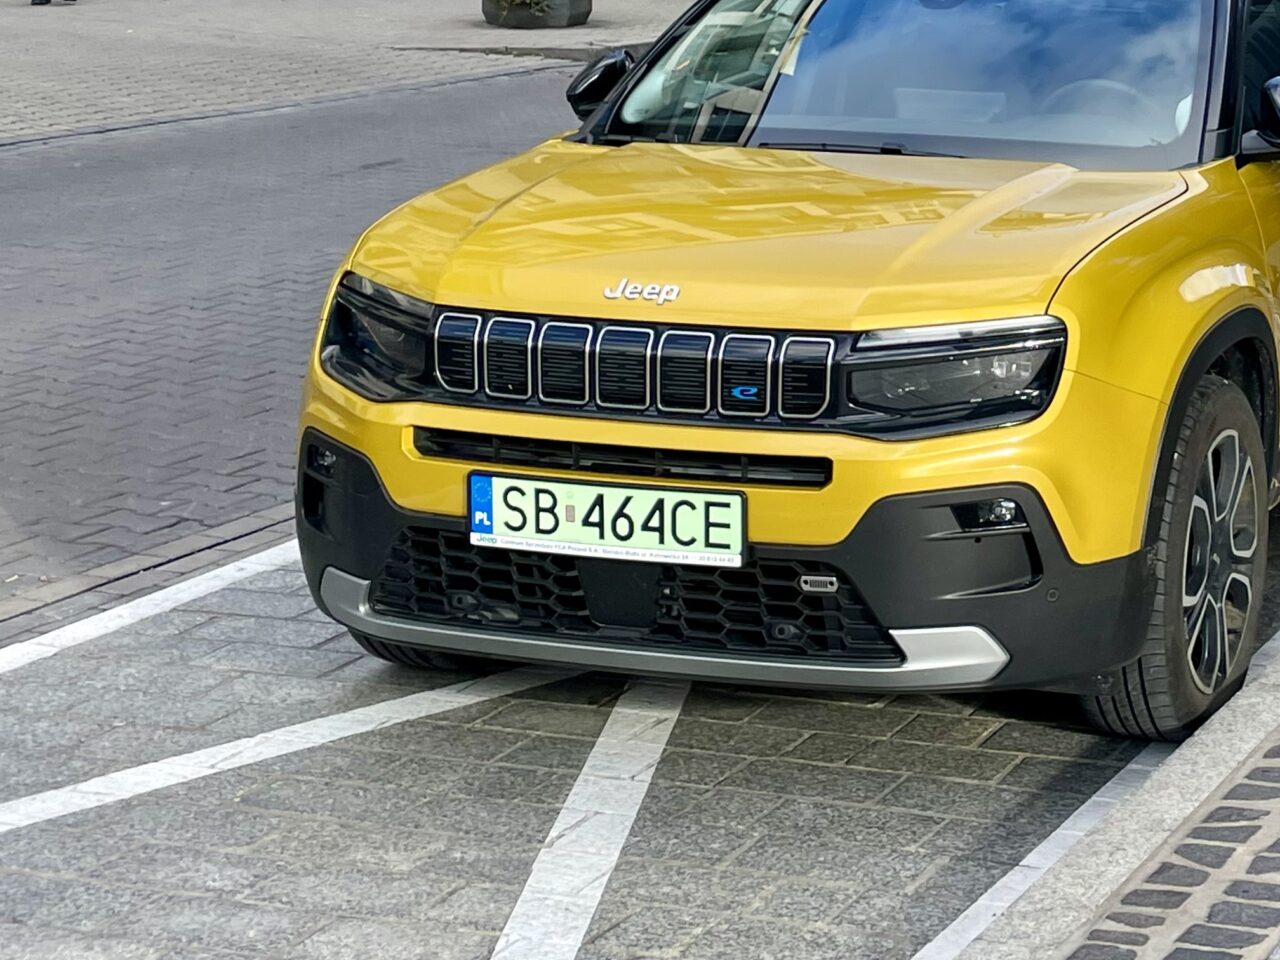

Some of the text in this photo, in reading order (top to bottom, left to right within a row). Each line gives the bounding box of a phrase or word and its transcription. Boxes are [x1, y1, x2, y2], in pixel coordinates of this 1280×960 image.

[603, 277, 680, 305] Jeep
[474, 511, 491, 526] PL
[502, 485, 732, 550] SB 464CE
